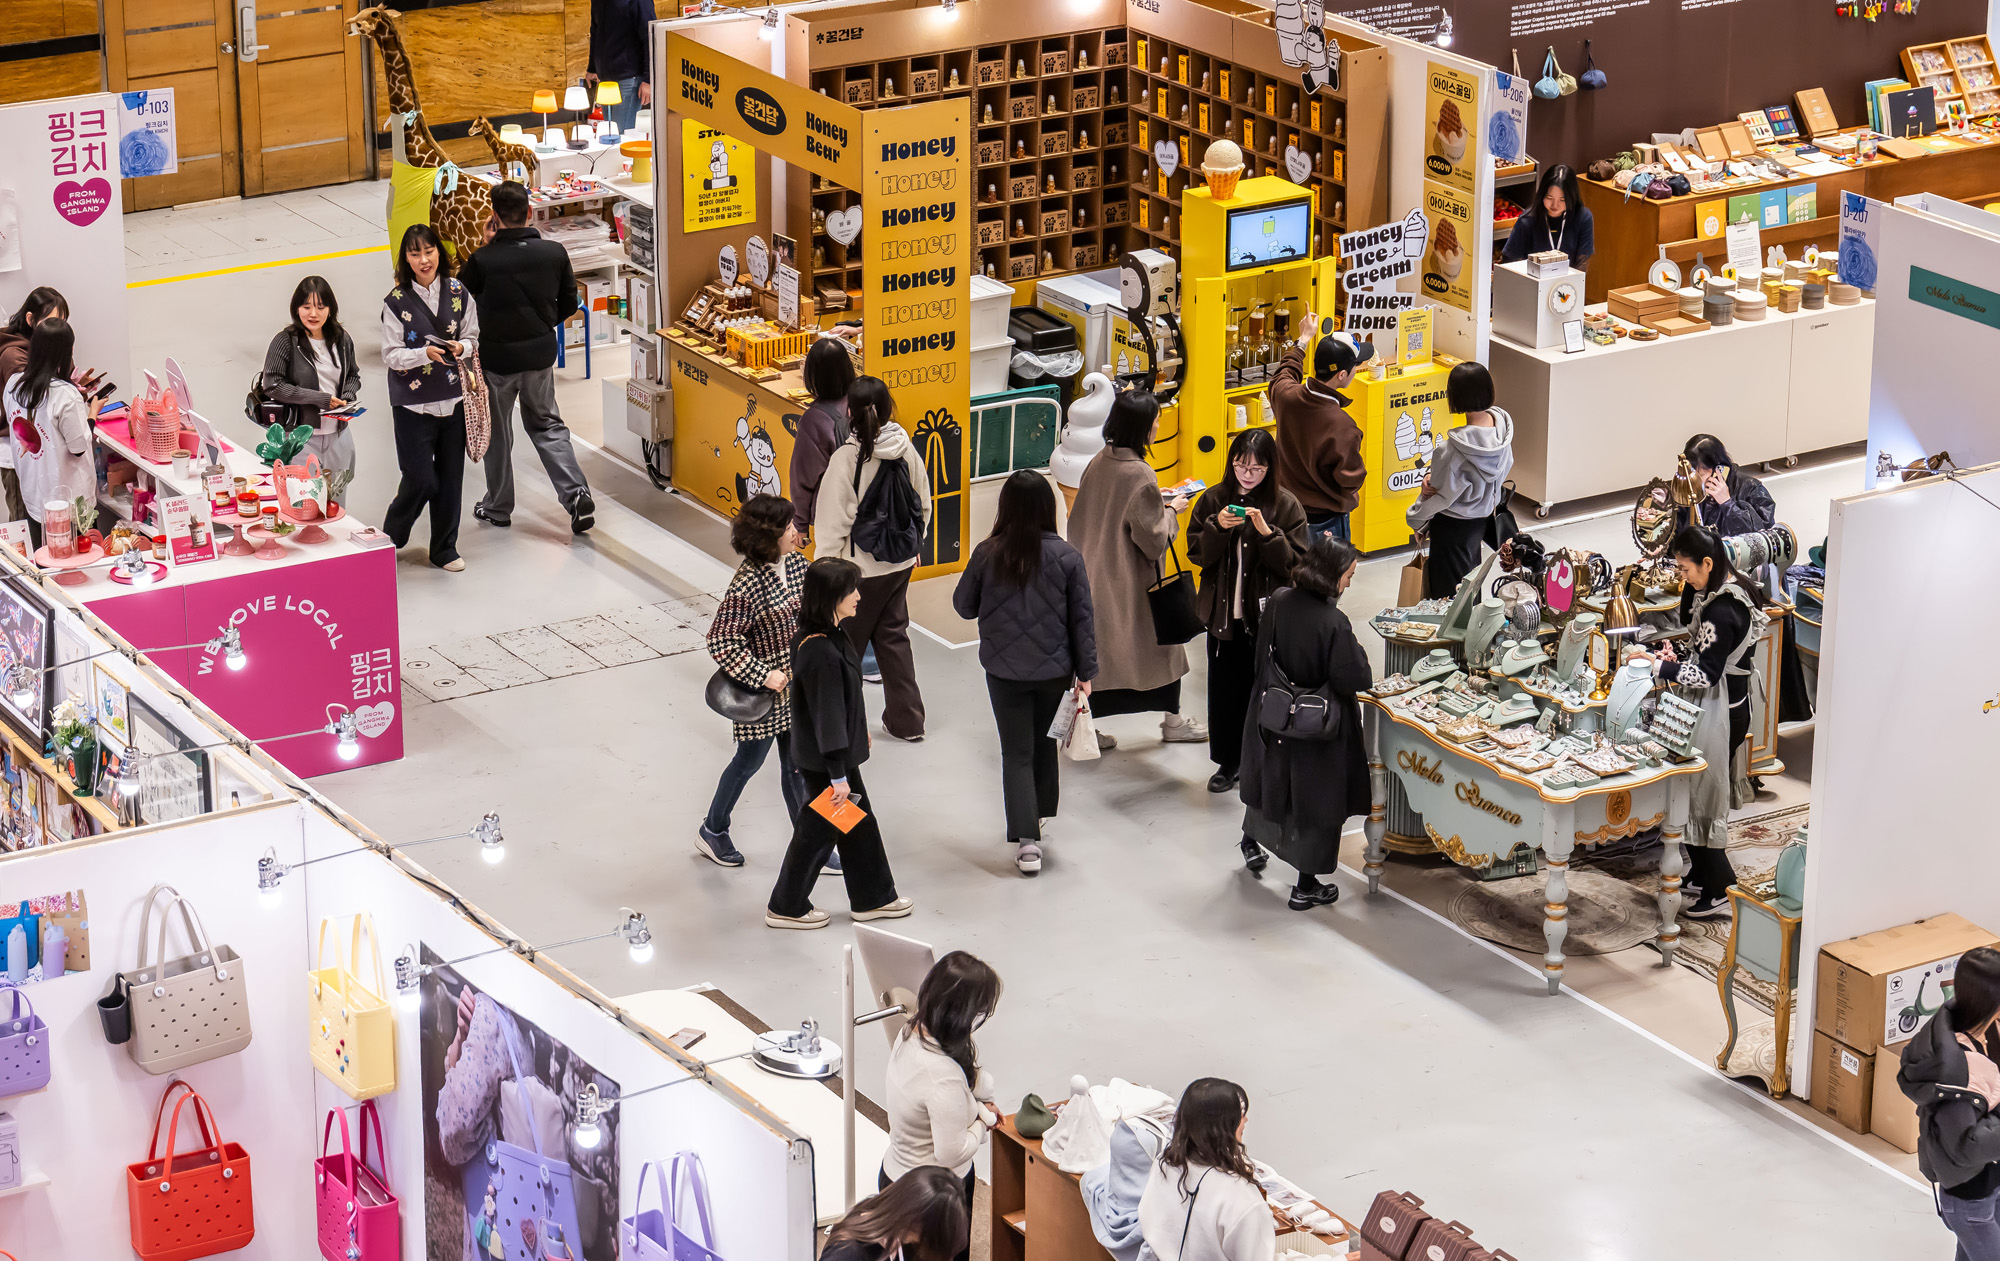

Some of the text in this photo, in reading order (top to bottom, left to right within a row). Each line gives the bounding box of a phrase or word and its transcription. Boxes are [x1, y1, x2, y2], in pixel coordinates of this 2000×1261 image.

[826, 27, 864, 42] 꿀건달
[682, 58, 720, 94] Honey
[1434, 77, 1471, 99] 아이스꿀임
[682, 81, 714, 110] Stick
[1503, 85, 1524, 104] D-206
[138, 100, 169, 116] D-103
[744, 95, 780, 128] 꿀건달
[48, 110, 107, 142] 핑크
[146, 120, 168, 128] 핑크김치
[806, 111, 848, 148] Honey
[51, 142, 106, 176] 김치
[806, 135, 840, 164] Bear
[882, 136, 956, 162] Honey
[69, 190, 96, 199] FROM
[882, 168, 956, 195] Honey
[60, 198, 106, 209] GANGHWA
[67, 206, 100, 216] ISLAND
[882, 202, 956, 228] Honey
[1430, 196, 1467, 218] 아이스꿀임
[1844, 205, 1868, 223] D-207
[882, 234, 956, 261] Honey
[1343, 225, 1402, 254] Honey
[1356, 248, 1388, 268] Ice
[882, 266, 956, 293] Honey
[1346, 259, 1412, 289] Cream
[1350, 294, 1412, 310] Honey
[1926, 286, 1950, 300] Mela
[882, 298, 956, 326] Honey
[1348, 314, 1398, 329] Hone
[882, 331, 956, 357] Honey
[1115, 333, 1146, 352] ICE CREA
[684, 361, 709, 386] 꿀건달
[882, 362, 956, 389] Honey
[1390, 397, 1408, 409] ICE
[1393, 472, 1424, 487] 아이스
[198, 636, 221, 675] WE
[285, 596, 344, 650] LOCAL
[350, 648, 392, 676] 핑크
[352, 672, 392, 700] 김치
[358, 716, 390, 726] GANGHWA
[363, 722, 385, 730] ISLAND
[1397, 750, 1522, 825] Mela Bianca
